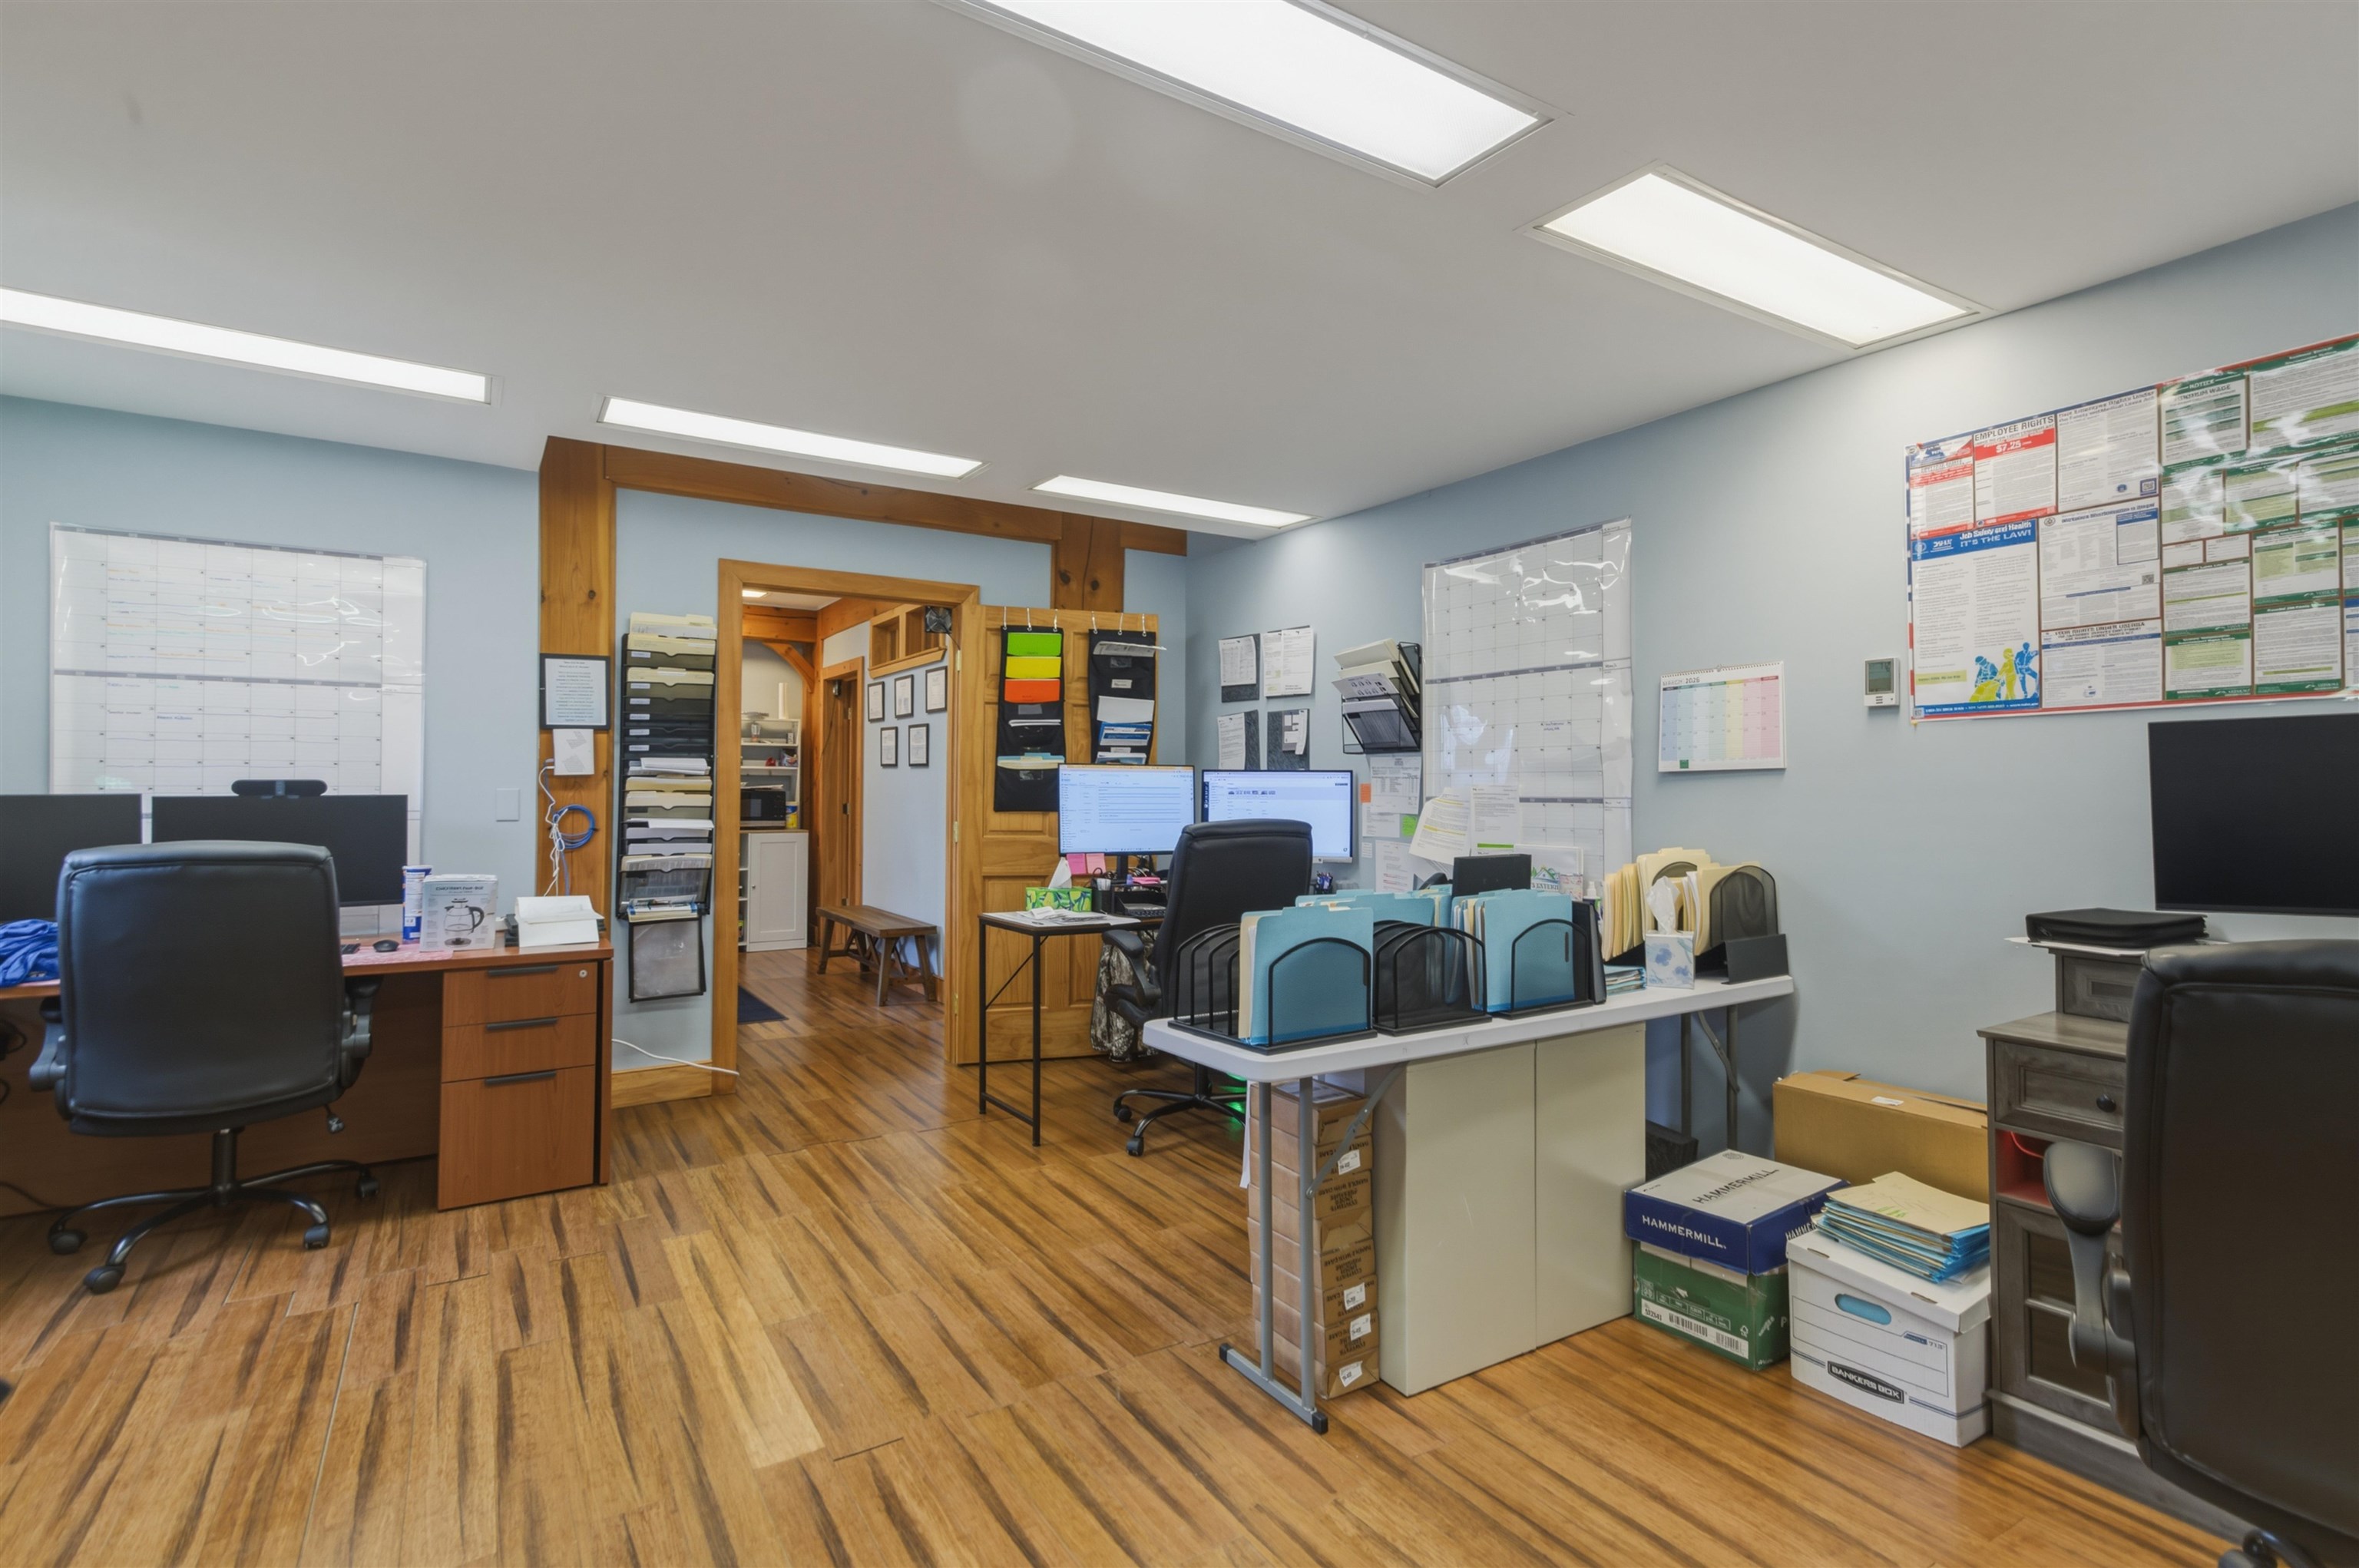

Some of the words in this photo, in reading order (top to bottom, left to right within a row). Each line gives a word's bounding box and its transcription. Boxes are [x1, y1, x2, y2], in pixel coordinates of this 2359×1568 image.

[1974, 424, 2019, 442] EMPLOYEE
[2021, 415, 2054, 431] RIGHTS
[1995, 440, 2022, 454] $7.25
[1960, 531, 1973, 540] Job
[1974, 528, 1994, 538] Safety
[1994, 524, 2008, 534] and
[2008, 521, 2032, 532] Health
[1960, 538, 1979, 547] IT'S
[1981, 534, 2001, 544] THE
[2003, 529, 2032, 540] LAW!
[1692, 1169, 1779, 1204] HAMMERMILL
[1642, 1215, 1725, 1249] HAMMERMILL
[1831, 1365, 1877, 1391] BANKERS
[1878, 1384, 1901, 1399] BOX
